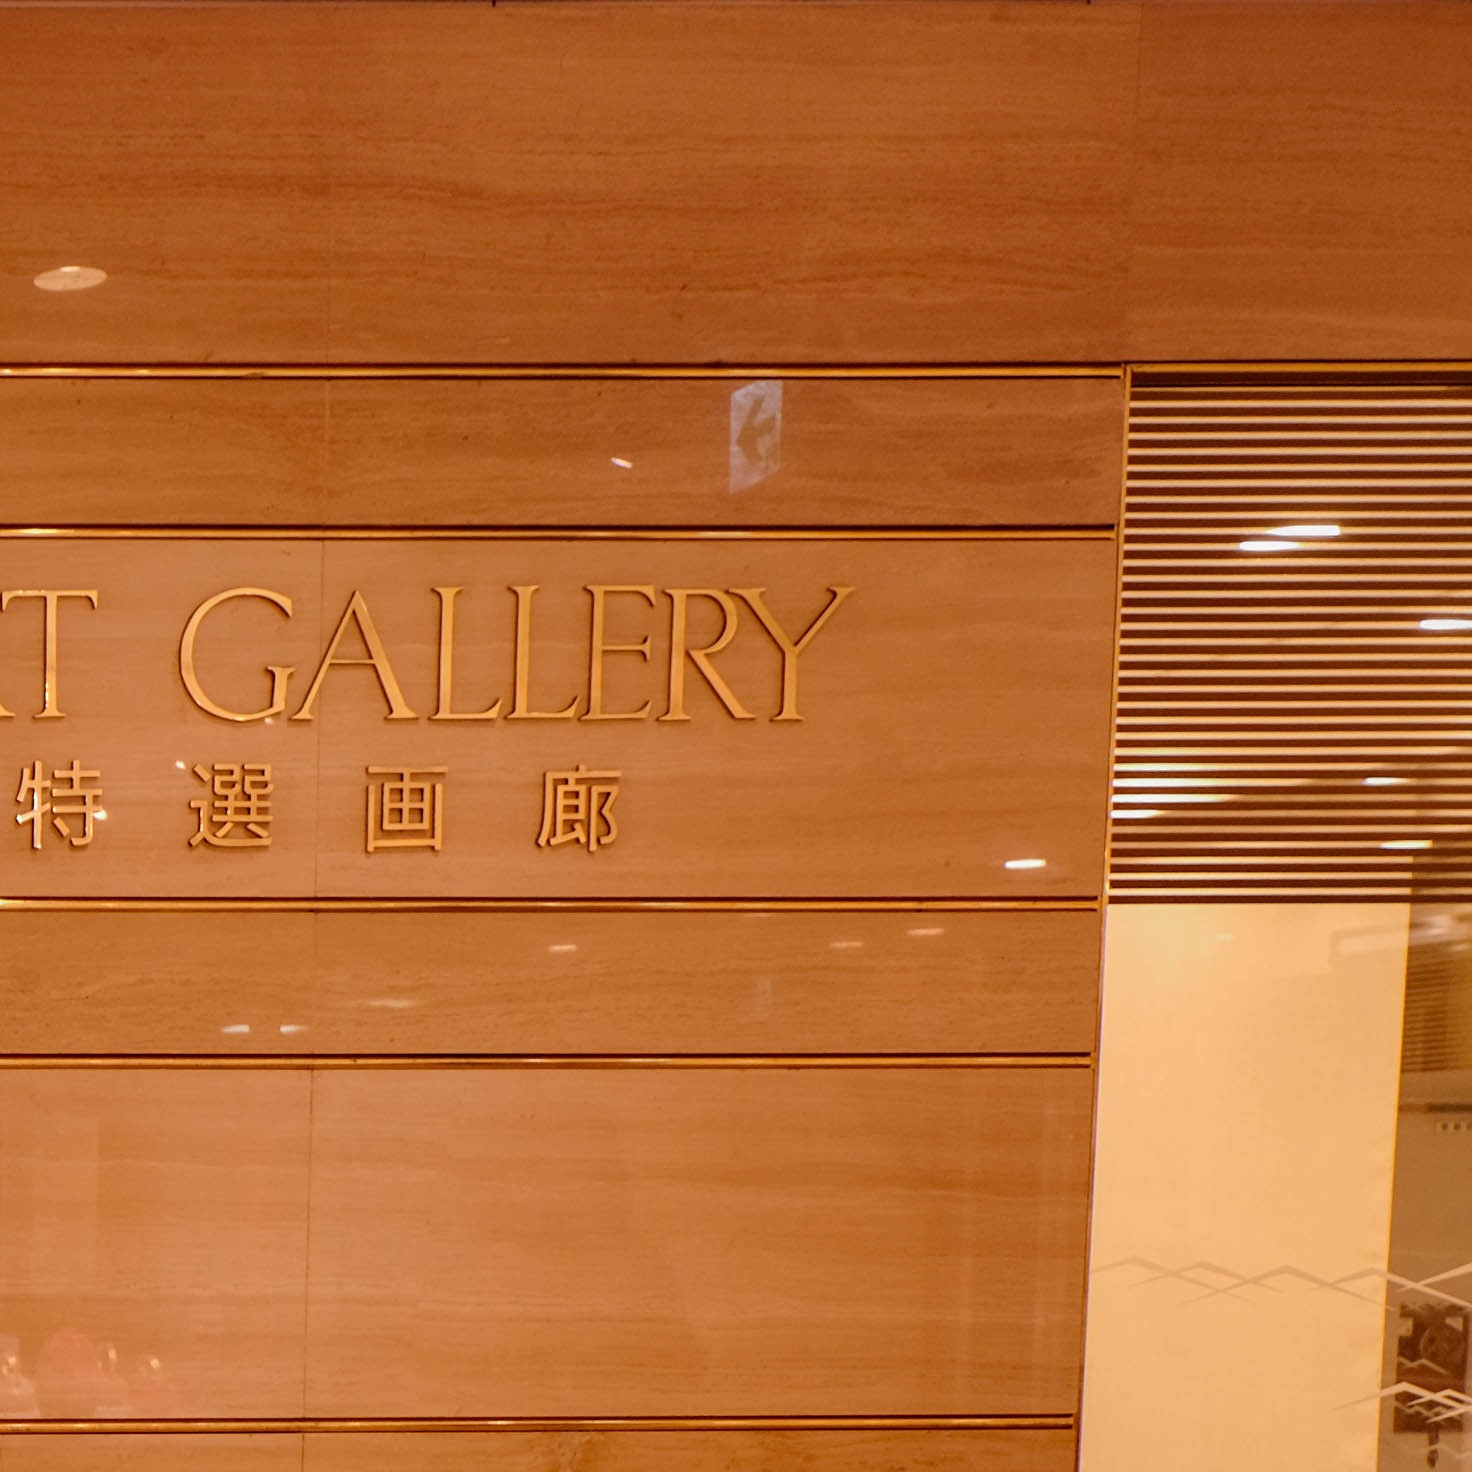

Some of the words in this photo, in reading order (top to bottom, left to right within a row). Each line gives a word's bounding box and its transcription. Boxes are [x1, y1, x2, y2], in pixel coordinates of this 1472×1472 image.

[179, 584, 855, 723] GALLERY
[15, 759, 623, 853] 特選画廊
